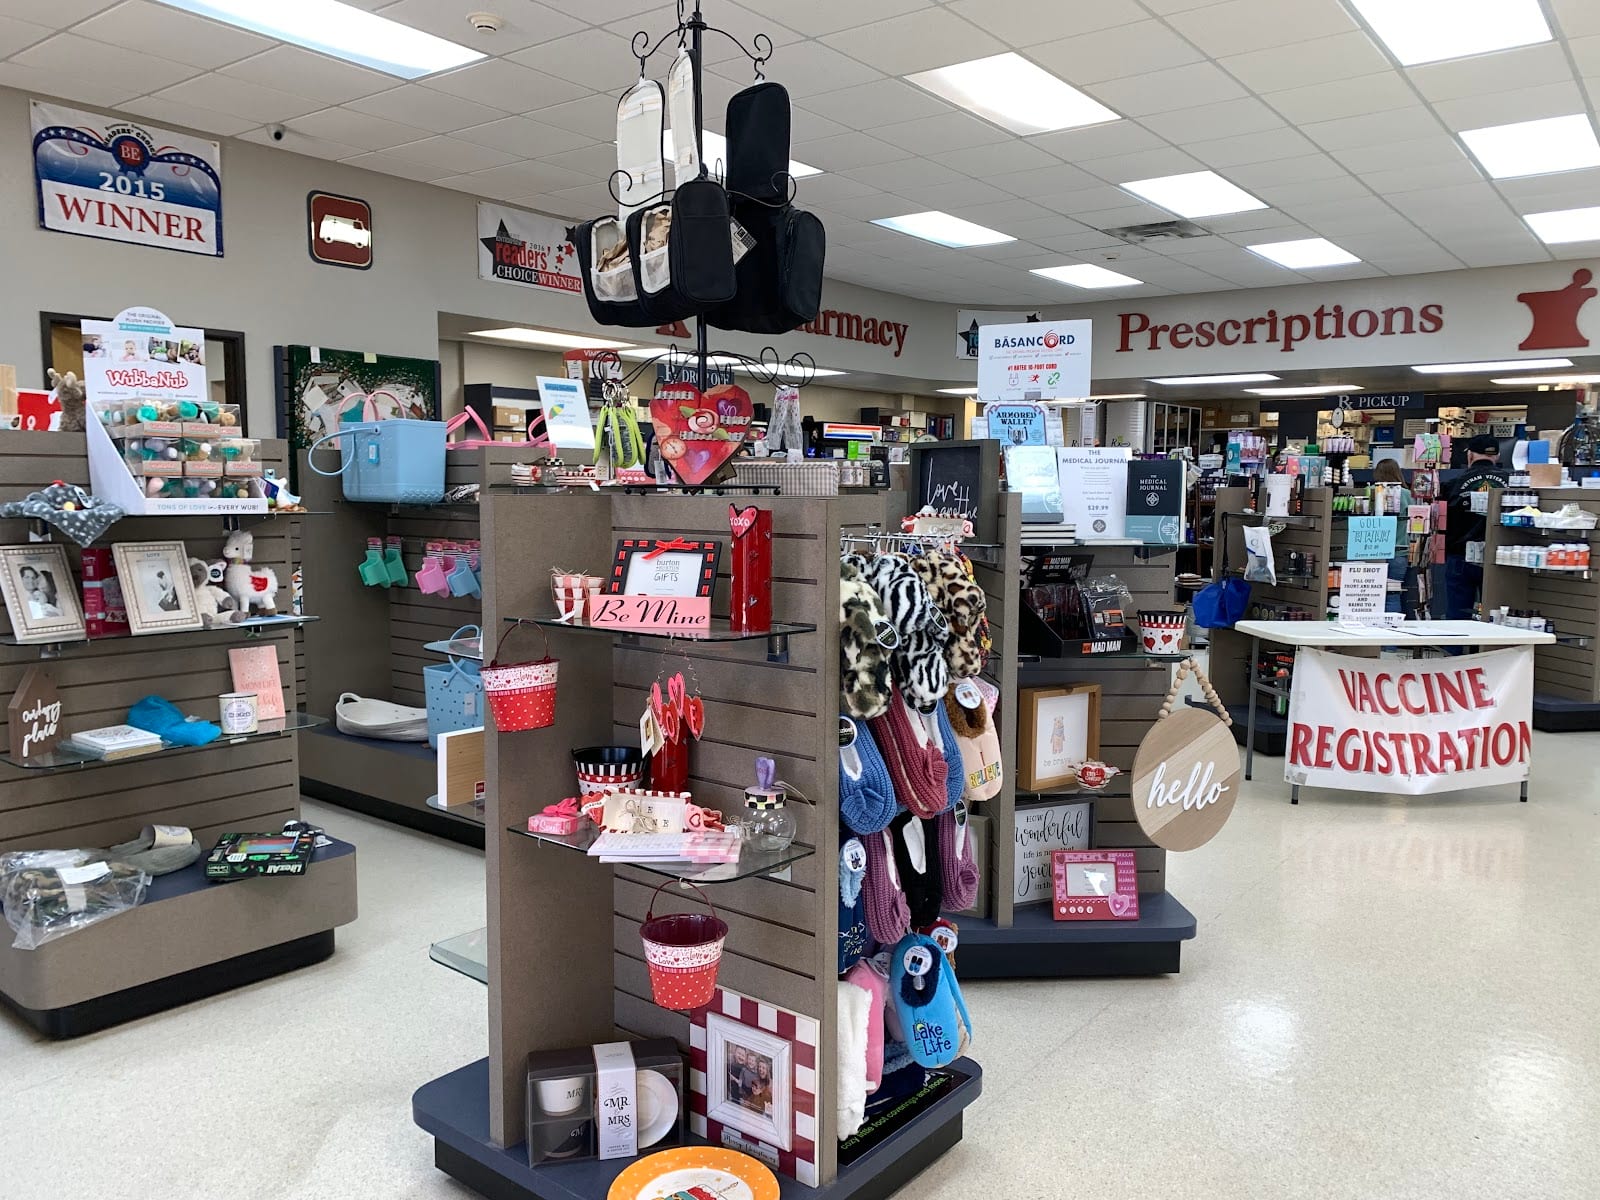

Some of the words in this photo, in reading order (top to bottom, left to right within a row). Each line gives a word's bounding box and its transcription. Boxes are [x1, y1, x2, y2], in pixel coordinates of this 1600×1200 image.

[120, 144, 140, 161] BE
[99, 172, 165, 200] 2015
[56, 193, 205, 243] WINNER
[529, 243, 545, 251] 2016
[1115, 304, 1444, 352] Prescriptions
[106, 369, 188, 389] WubbaNub
[1359, 395, 1410, 407] PICK-UP
[730, 516, 750, 528] XOXO
[654, 572, 680, 582] GIFTS
[592, 599, 630, 623] Be
[636, 599, 706, 625] Mine
[1091, 641, 1106, 653] MAD
[1107, 640, 1122, 652] MAN
[1337, 667, 1496, 716] VACCINE
[1289, 721, 1532, 776] REGISTRATION
[968, 762, 1002, 789] BELIEVE
[1147, 761, 1229, 811] hello
[1023, 850, 1034, 859] life
[912, 1022, 943, 1041] Lake
[923, 1036, 952, 1056] Life
